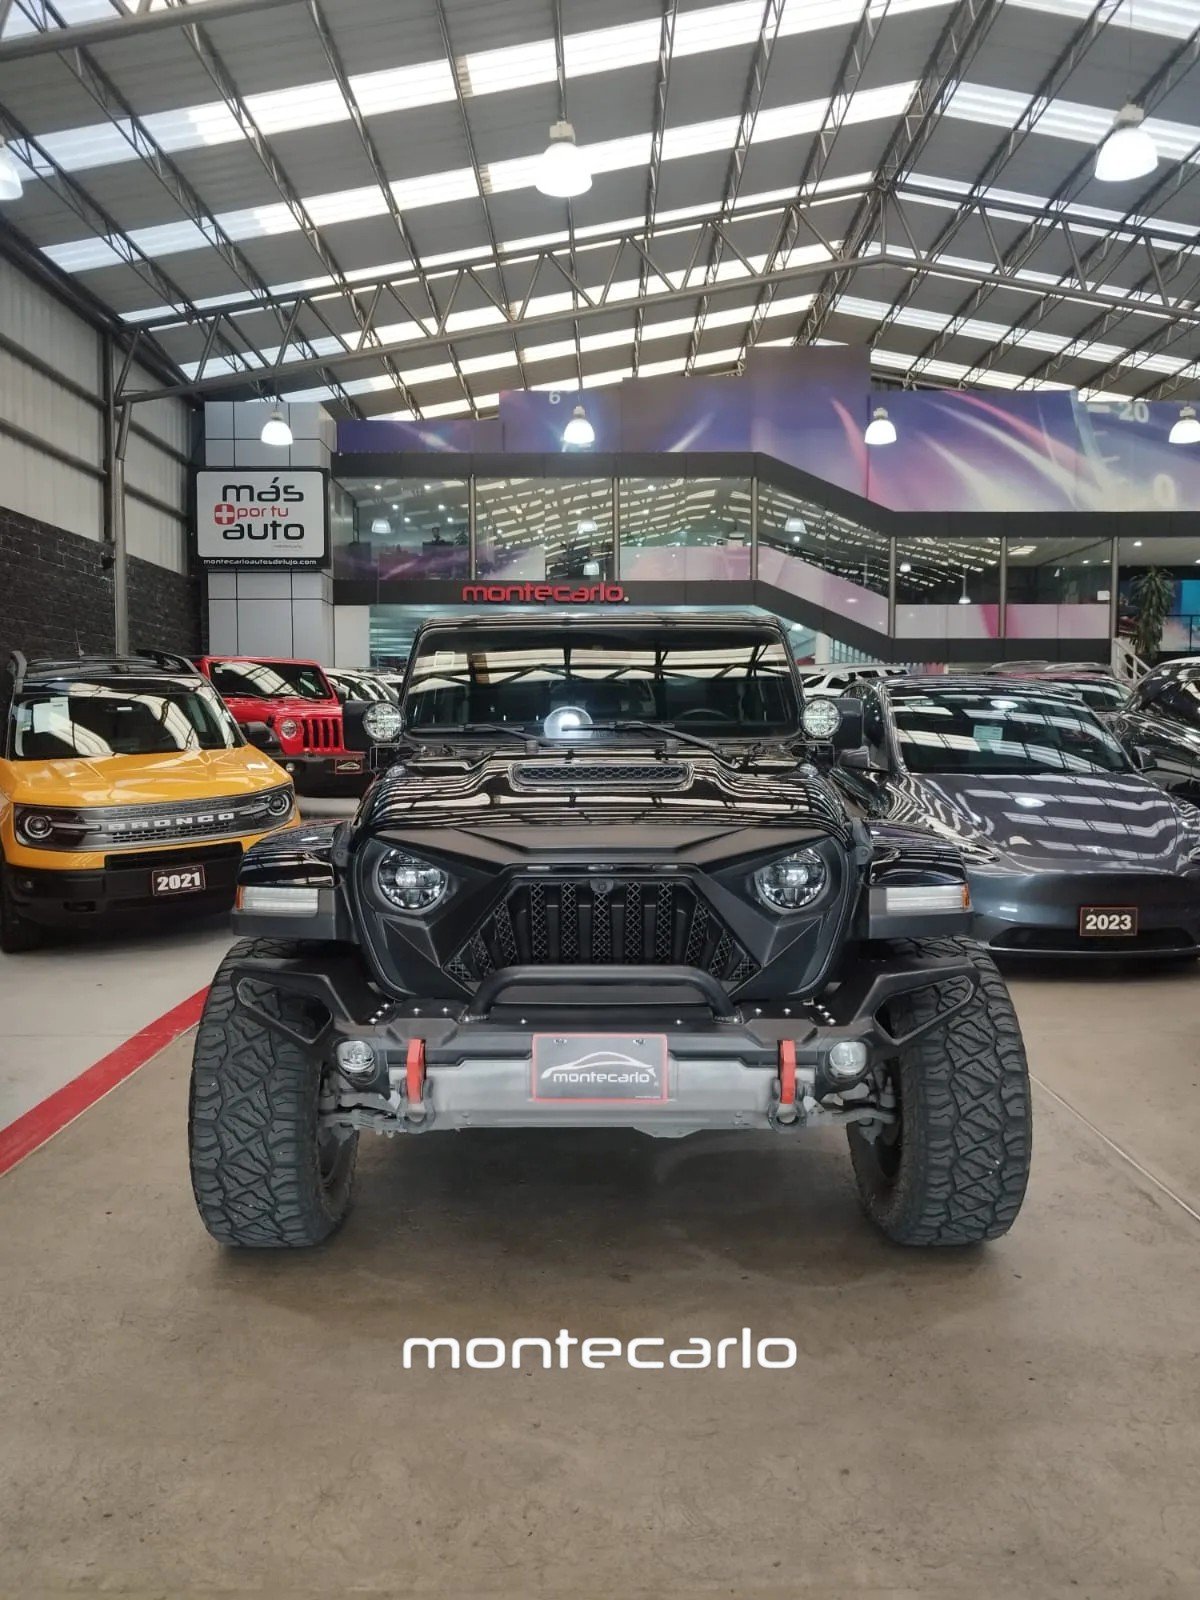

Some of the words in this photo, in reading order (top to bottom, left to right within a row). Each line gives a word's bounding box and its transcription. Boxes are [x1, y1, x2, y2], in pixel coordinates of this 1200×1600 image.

[222, 476, 304, 502] más
[237, 507, 266, 520] por
[271, 505, 289, 518] tu
[222, 520, 305, 540] auto
[108, 813, 235, 831] BRONCO
[156, 872, 202, 891] 2021
[1085, 914, 1132, 930] 2023
[552, 1071, 651, 1084] montecarlo
